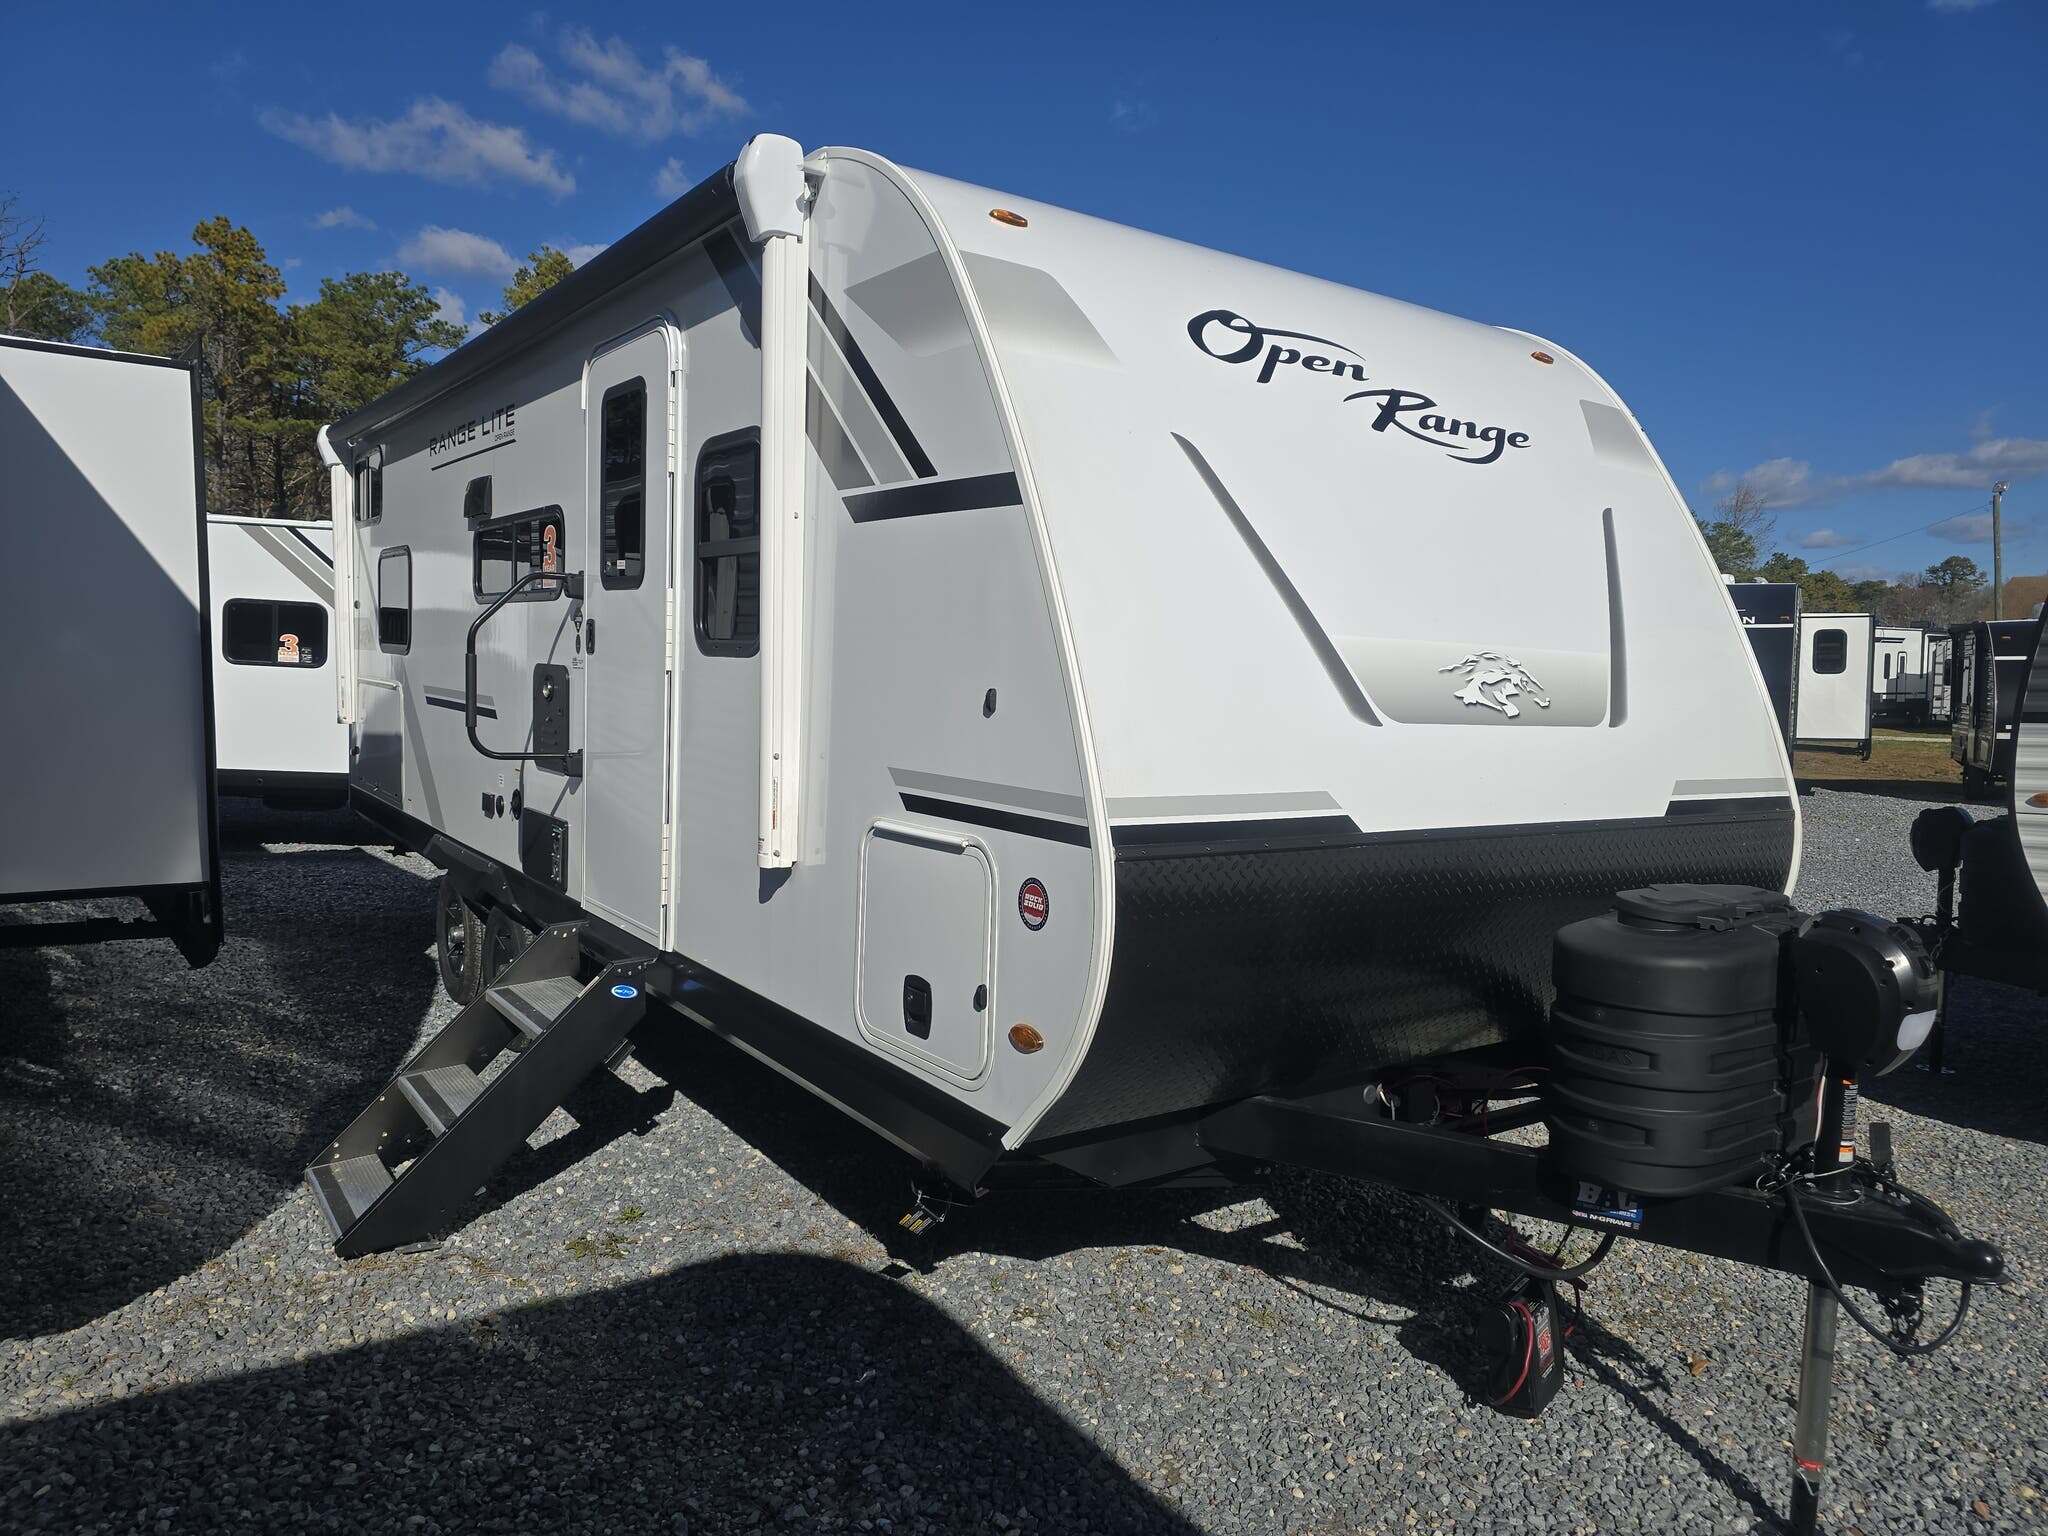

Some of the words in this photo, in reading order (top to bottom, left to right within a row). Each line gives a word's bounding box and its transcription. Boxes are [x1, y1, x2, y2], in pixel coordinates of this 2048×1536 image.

[1187, 309, 1370, 384] Open
[429, 419, 476, 457] RANGE
[481, 403, 516, 436] LITE
[1343, 388, 1532, 465] Range
[543, 524, 557, 563] 3
[1741, 616, 1756, 624] N
[279, 633, 299, 655] 3
[1023, 900, 1044, 911] SOLID
[1024, 893, 1043, 904] ROCK
